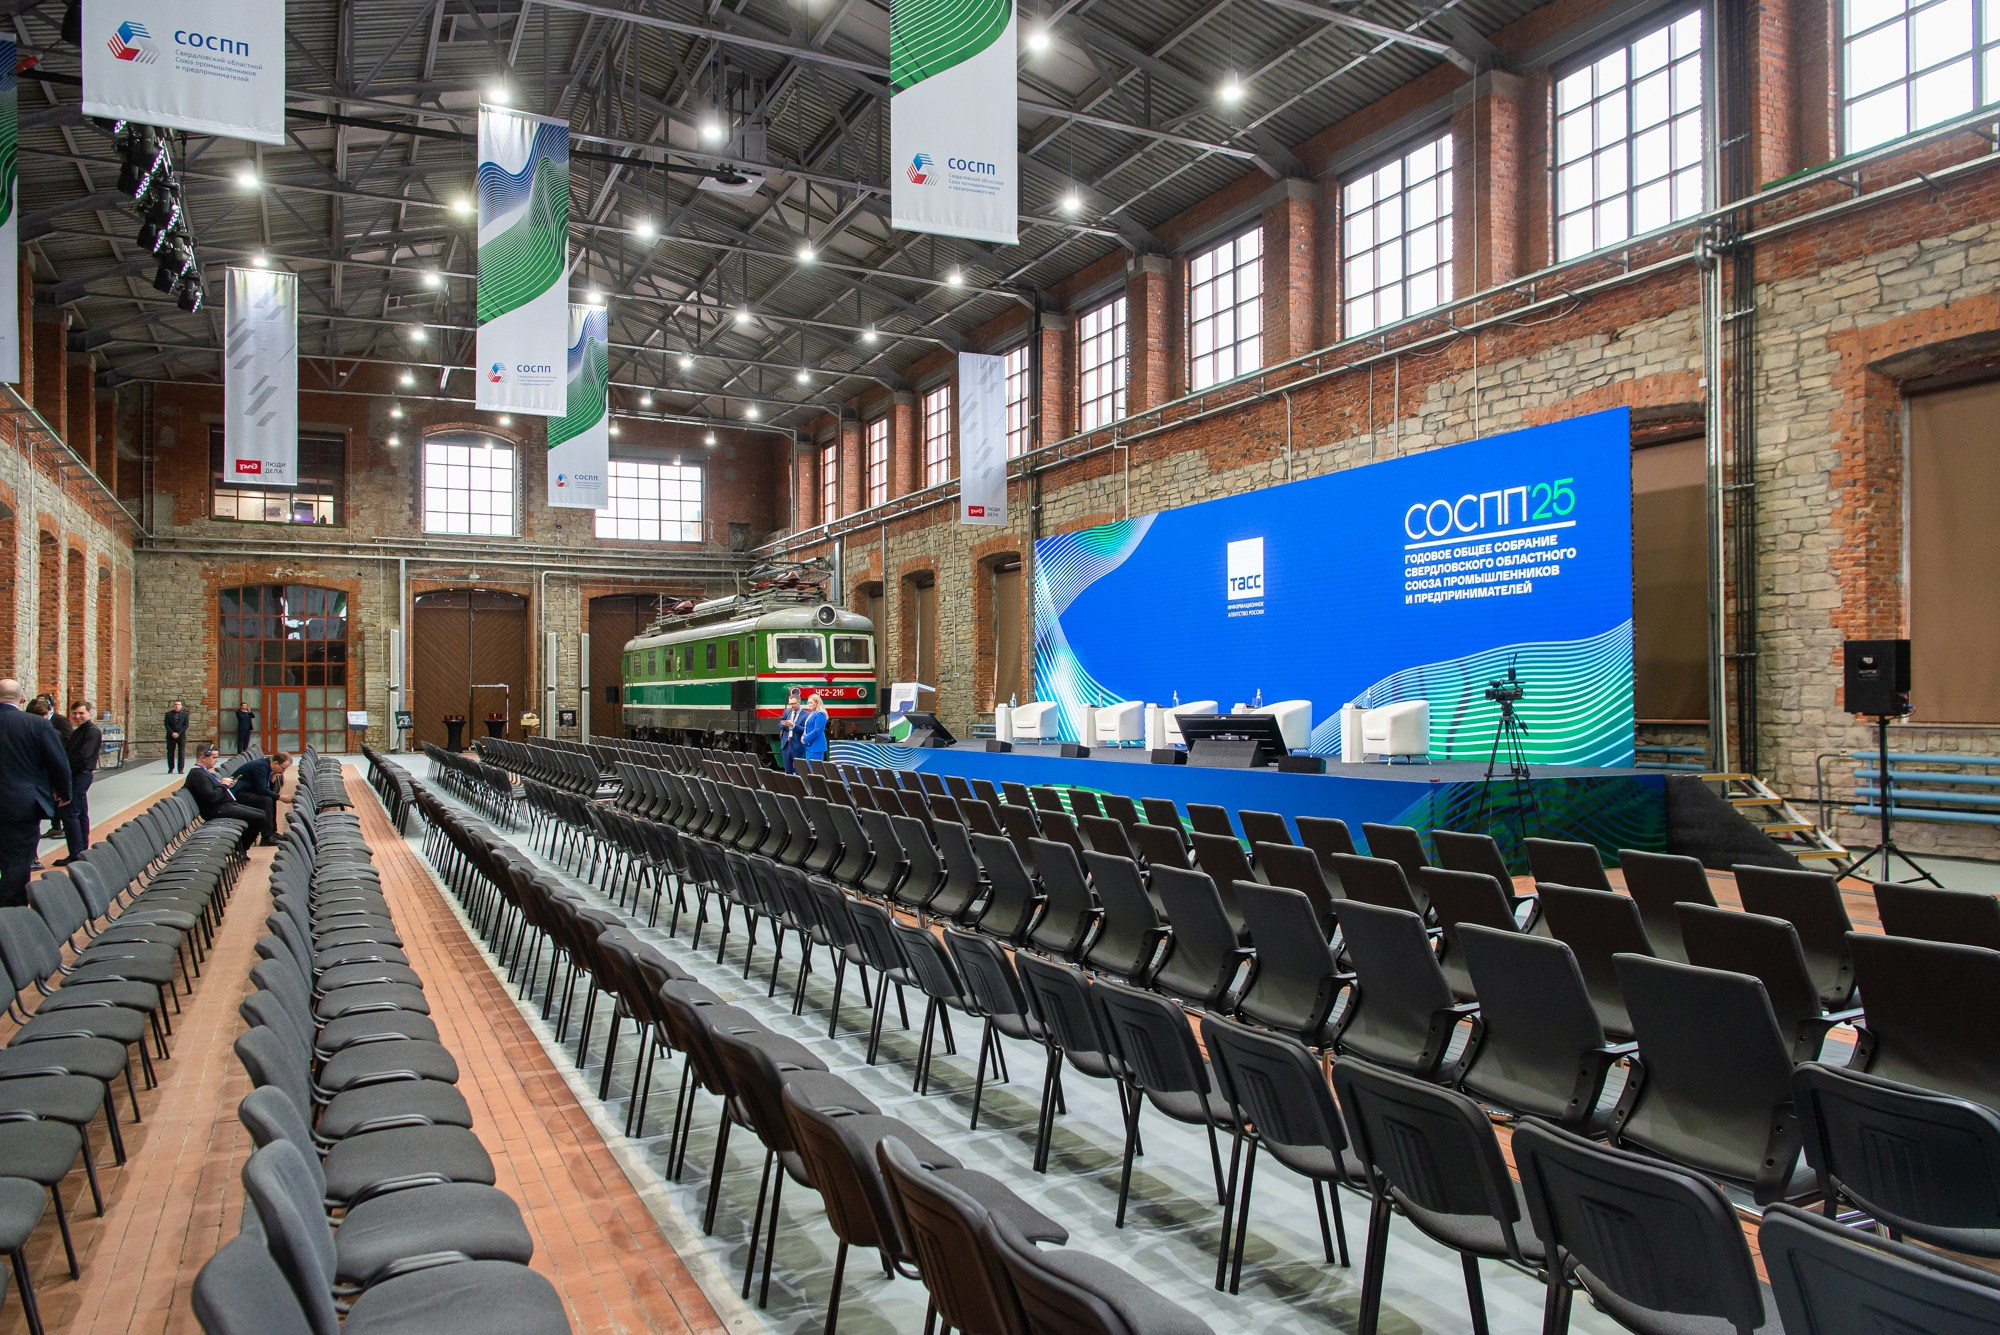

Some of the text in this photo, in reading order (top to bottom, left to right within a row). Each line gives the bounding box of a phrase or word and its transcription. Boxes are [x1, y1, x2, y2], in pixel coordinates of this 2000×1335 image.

[174, 30, 249, 56] СОСПП
[175, 49, 263, 70] Свердловский областной
[175, 56, 257, 77] Союз промышленников
[181, 66, 250, 83] предпринимателей
[948, 157, 995, 175] СОСПП
[516, 364, 551, 373] СОСПП
[1404, 534, 1558, 565] ГОДОВОЕ ОБЩЕЕ СОБРАНИЕ
[1404, 547, 1577, 578] СВЕРДЛОВСКОГО ОБЛАСТНОГО
[1404, 565, 1560, 591] СОЮЗА ПРОМЫШЛЕННИКОВ
[1405, 580, 1532, 605] И ПРЕДПРИНИМАТЕЛЕЙ
